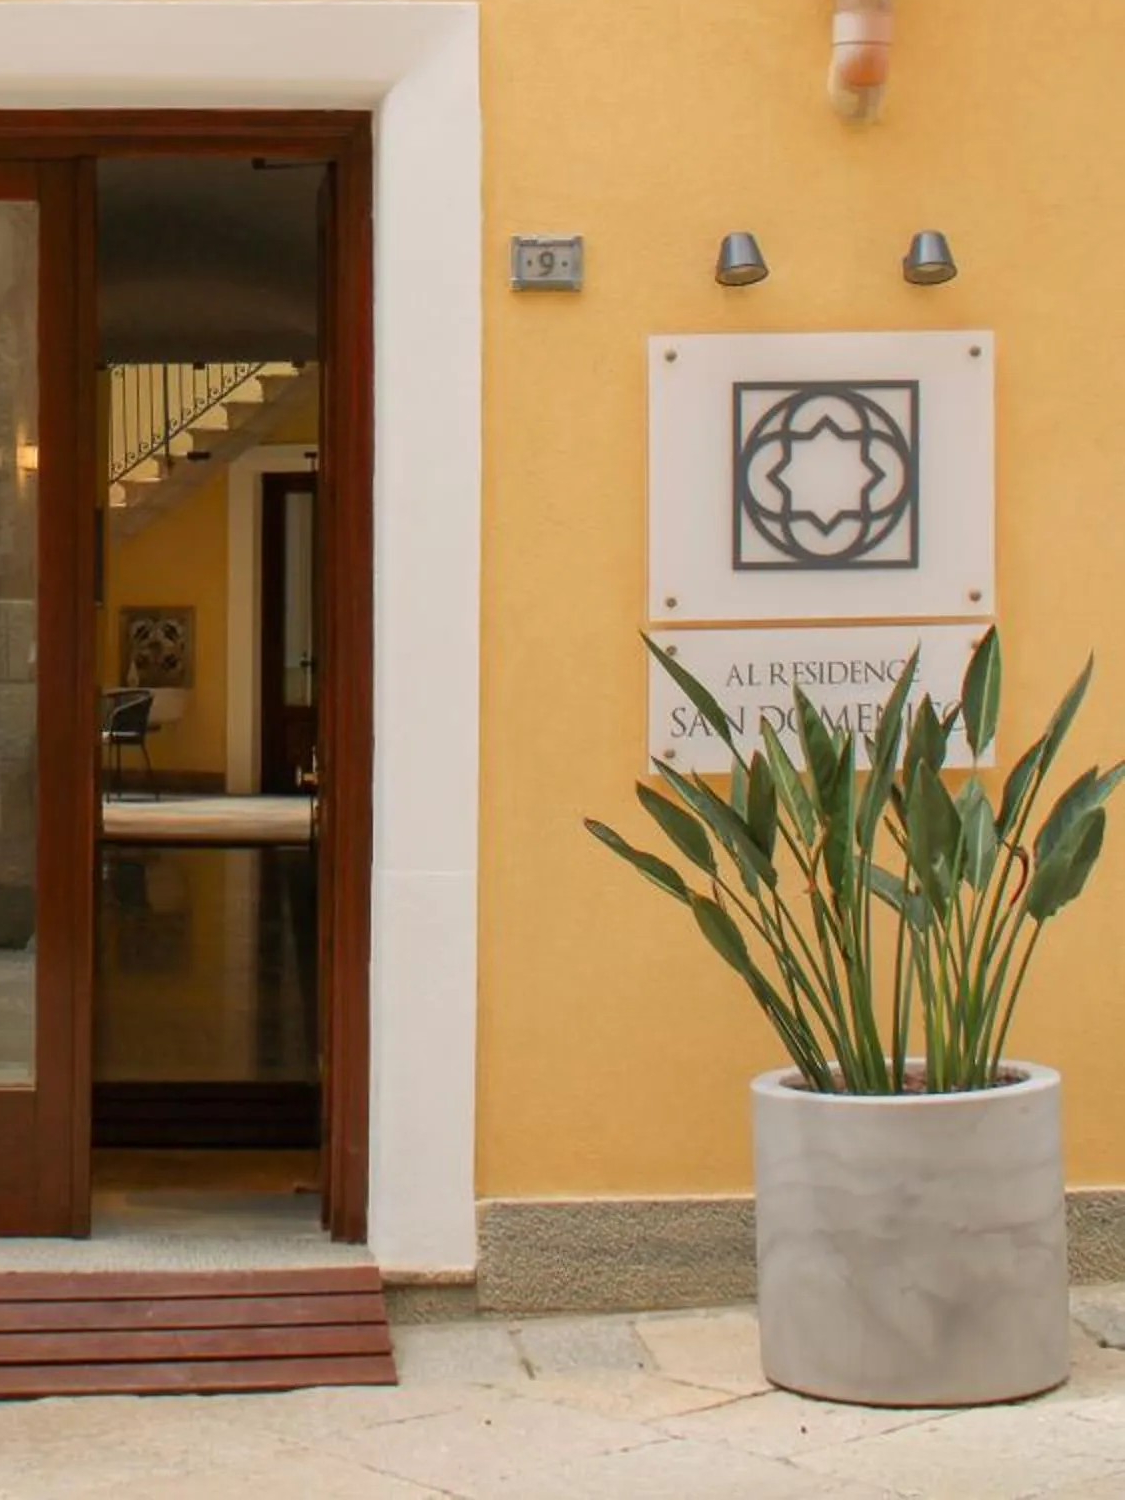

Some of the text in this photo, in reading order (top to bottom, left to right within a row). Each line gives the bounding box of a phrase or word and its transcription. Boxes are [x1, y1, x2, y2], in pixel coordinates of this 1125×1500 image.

[539, 251, 555, 277] 9
[725, 662, 762, 687] AL
[670, 705, 745, 738] SAN
